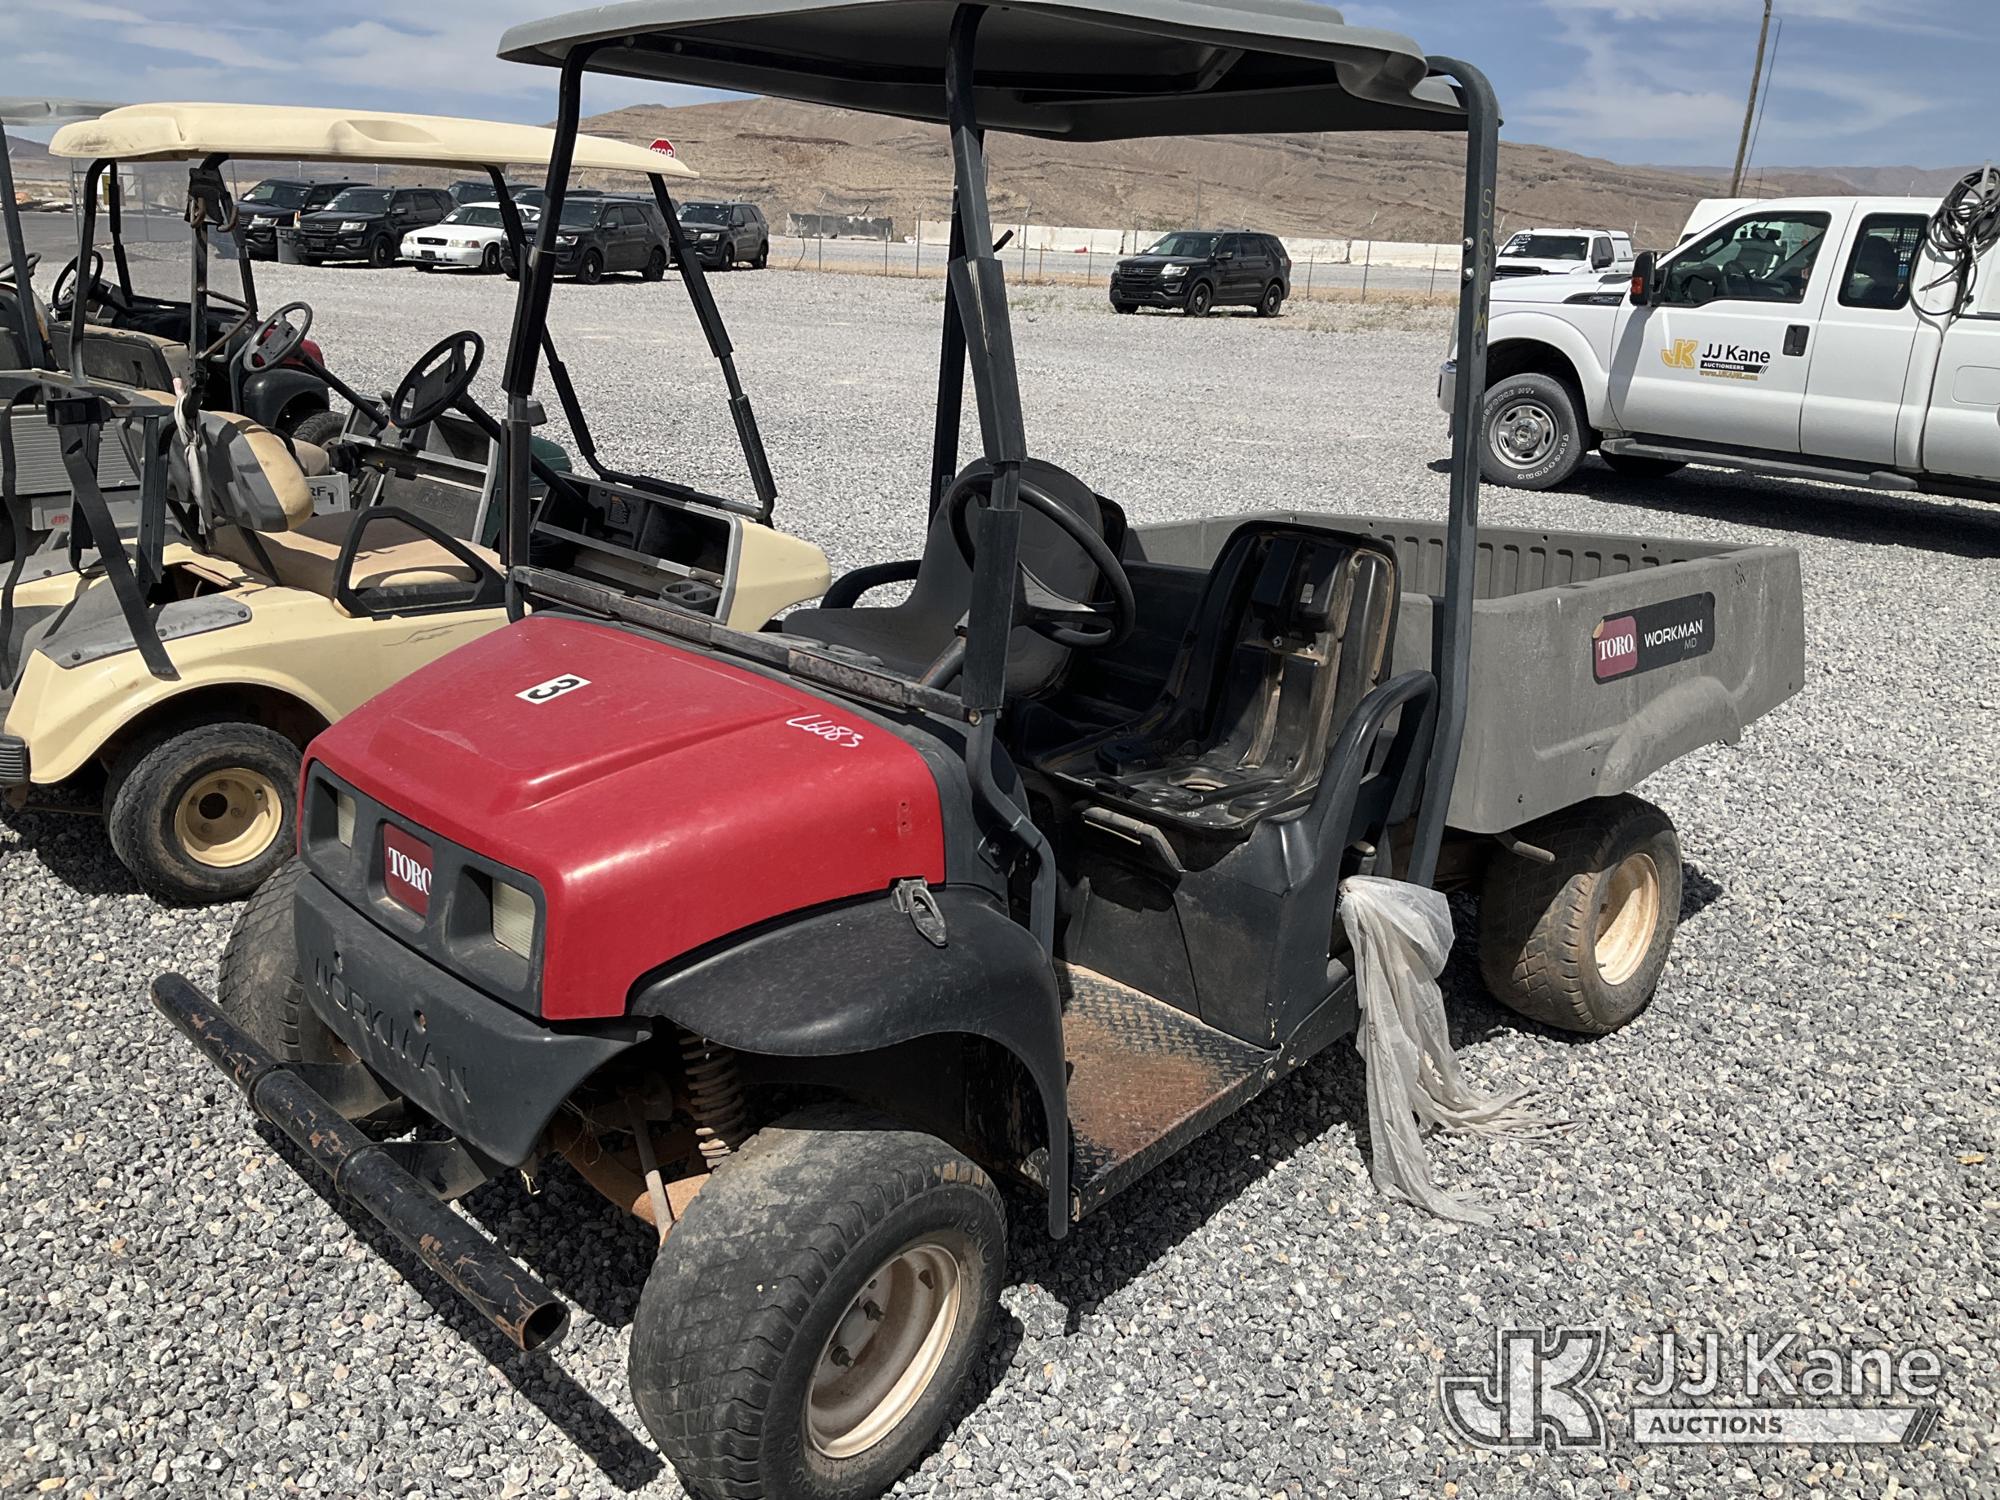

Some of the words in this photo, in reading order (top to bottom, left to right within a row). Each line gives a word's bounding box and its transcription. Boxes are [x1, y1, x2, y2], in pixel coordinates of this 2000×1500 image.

[1702, 343, 1722, 359] JJ
[1725, 344, 1771, 364] Kane
[1703, 362, 1745, 371] AUCTIONEERS
[1644, 619, 1704, 648] WORKMAN
[1684, 637, 1698, 650] MD
[1598, 633, 1634, 661] TORO
[527, 678, 580, 699] 3
[387, 846, 432, 896] TORO
